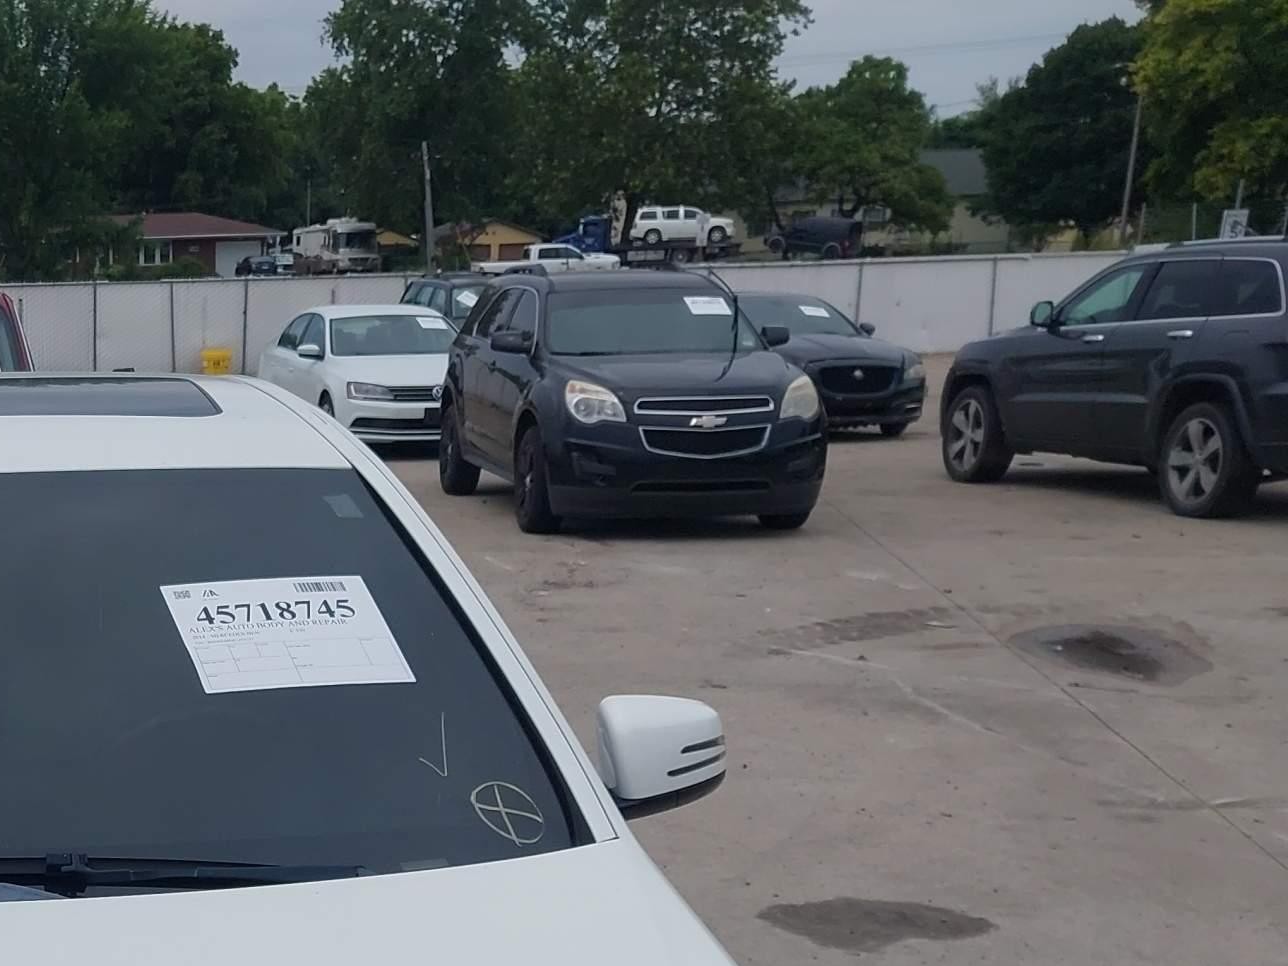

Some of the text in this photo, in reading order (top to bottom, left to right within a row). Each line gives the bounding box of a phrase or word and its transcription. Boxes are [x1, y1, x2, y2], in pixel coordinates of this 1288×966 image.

[197, 599, 356, 625] 45718745
[226, 623, 255, 631] AUTO
[256, 621, 284, 629] BODY
[288, 619, 310, 627] AND
[311, 618, 348, 626] REPAIR
